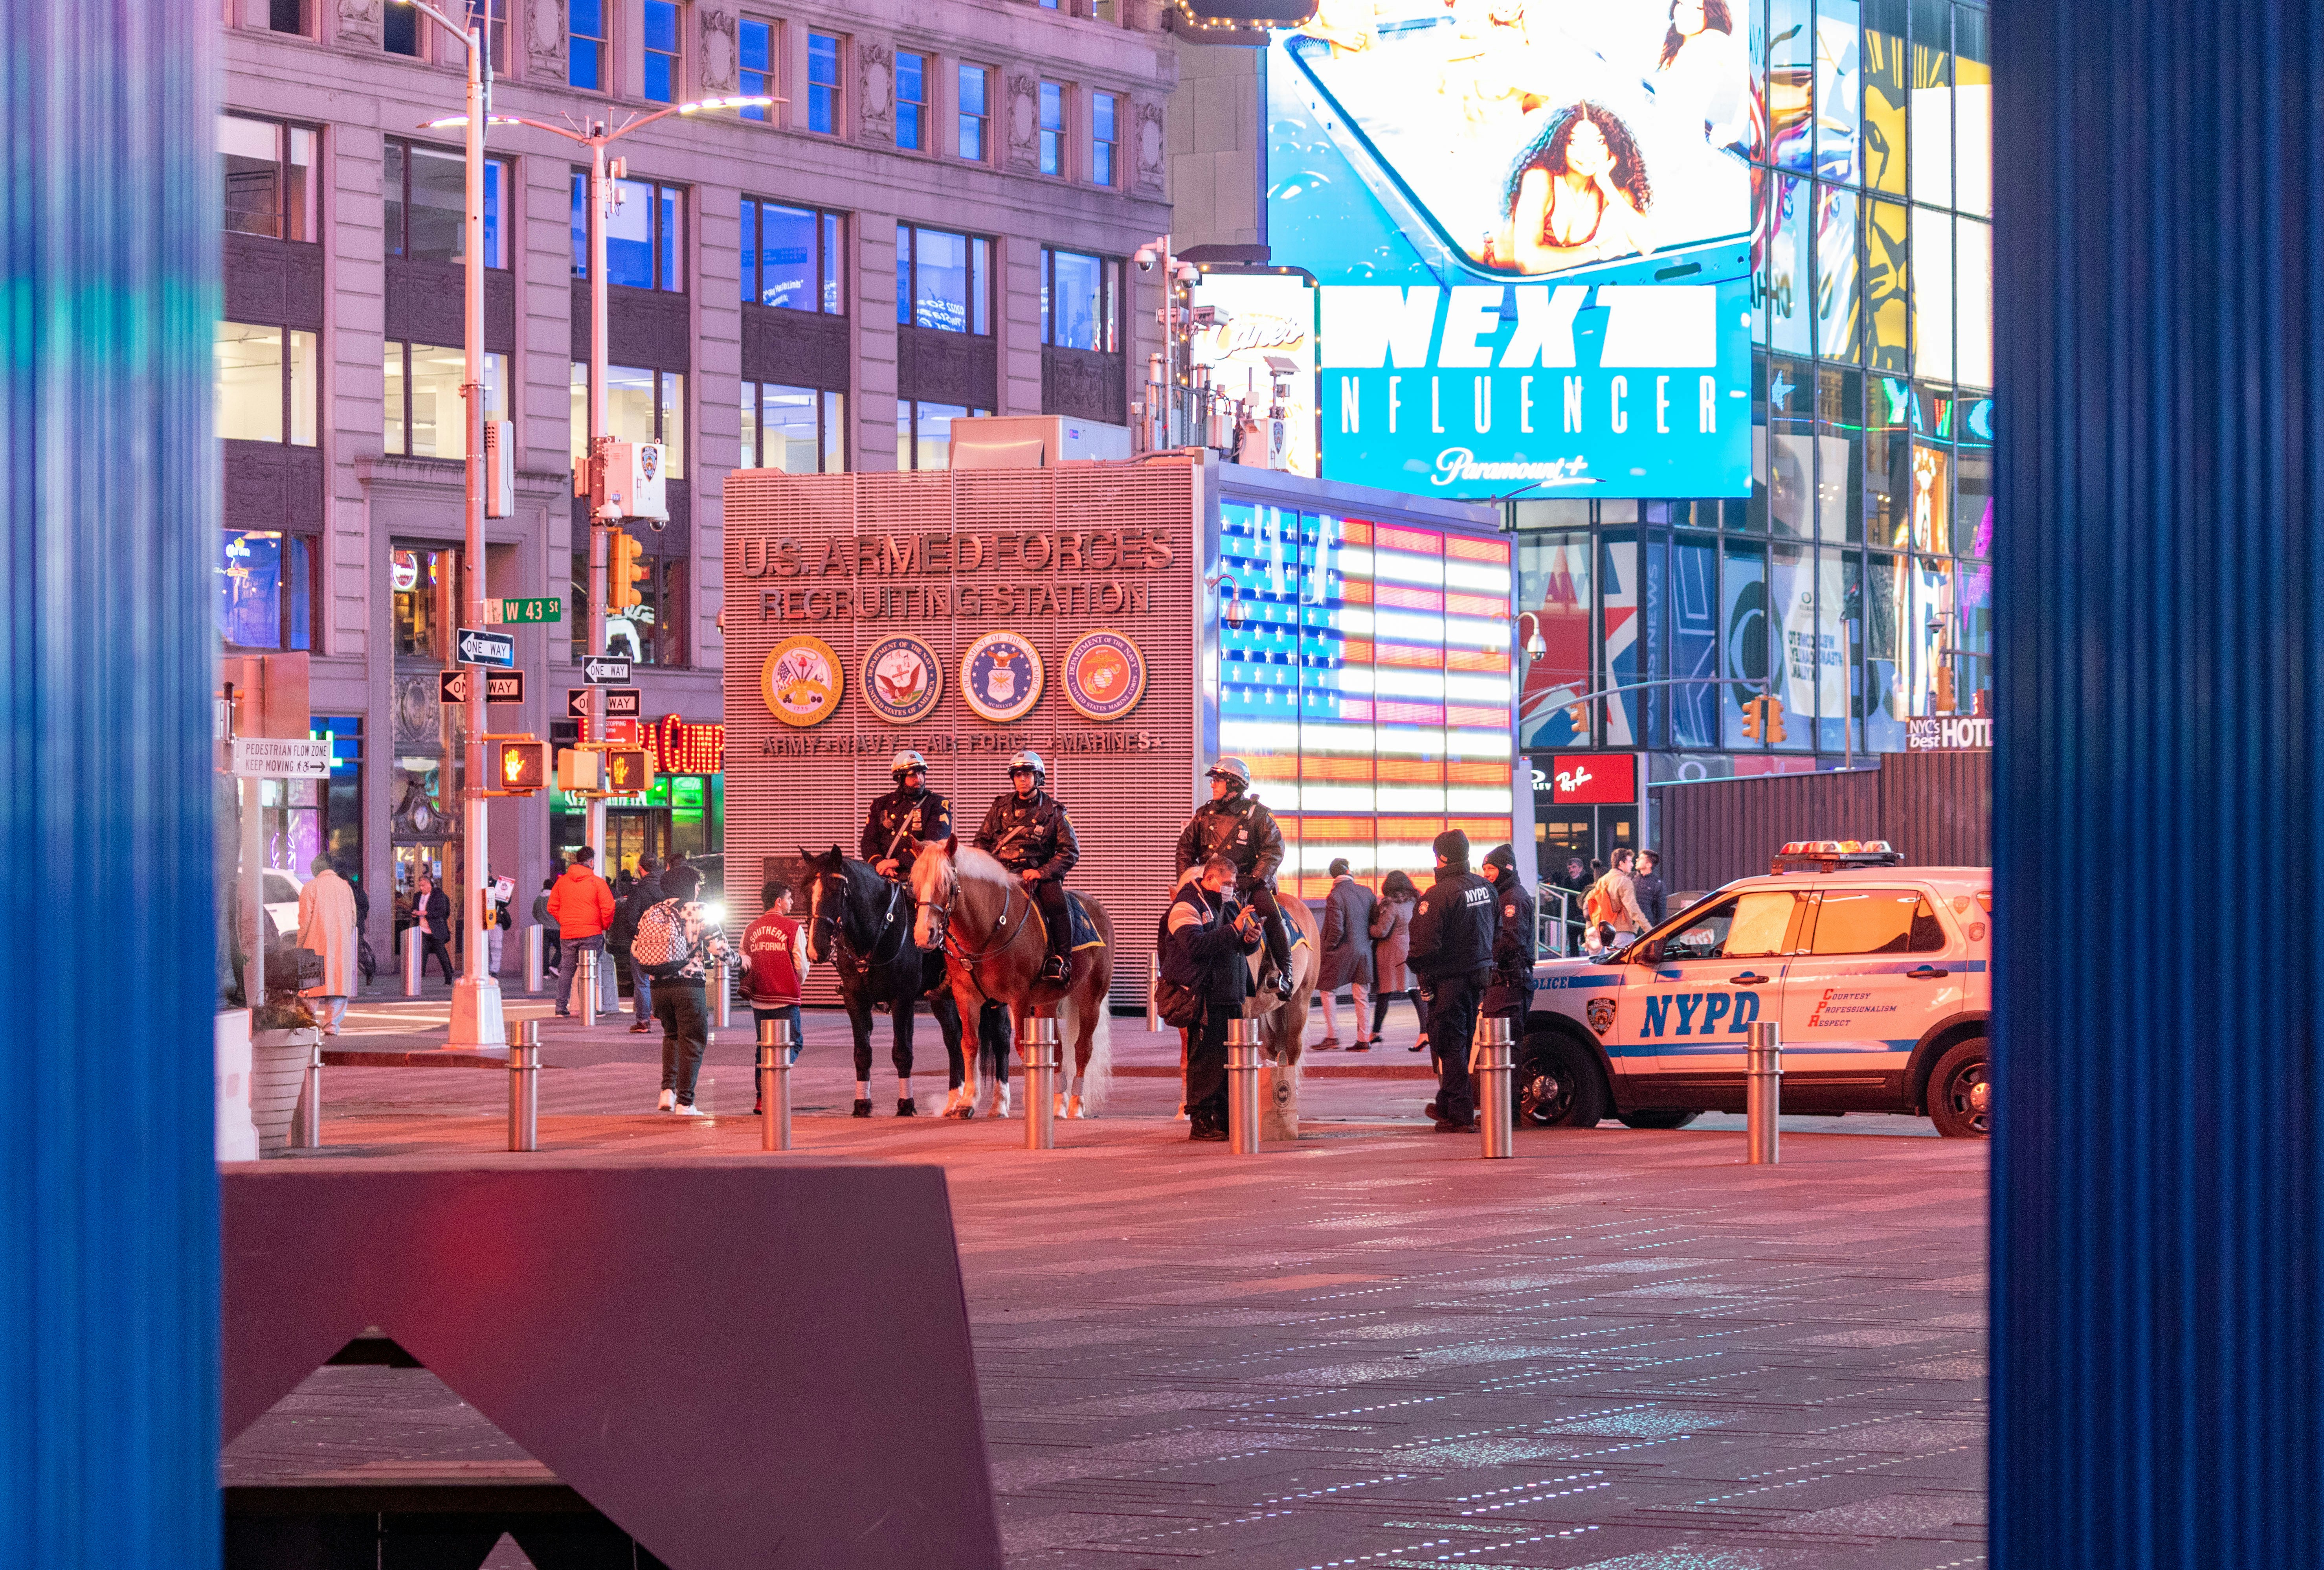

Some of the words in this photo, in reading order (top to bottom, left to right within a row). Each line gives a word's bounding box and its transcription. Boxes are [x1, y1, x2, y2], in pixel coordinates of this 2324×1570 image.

[1321, 285, 1716, 368] NEXT
[1342, 375, 1716, 434] NFLUENCER
[1432, 447, 1588, 485] Paramount+
[738, 537, 809, 577] U.S.
[817, 533, 983, 575] ARMED
[991, 529, 1174, 570] FORCES
[759, 584, 980, 620] RECRUITING
[992, 581, 1149, 614] STATION
[1647, 564, 1658, 647] NEWS
[506, 602, 519, 620] W
[526, 601, 543, 620] 43
[549, 601, 558, 612] St
[466, 640, 483, 653] ONE
[490, 643, 506, 656] WAY
[1069, 636, 1103, 675] DEPARTMENT
[1113, 639, 1124, 649] THE
[1123, 647, 1138, 668] NAVY
[767, 640, 802, 675] DEPARTMENT
[818, 645, 829, 656] THE
[830, 659, 840, 679] ARMY
[867, 642, 897, 677] DEPARTMENT
[911, 643, 923, 654] THE
[922, 653, 934, 670] NAVY
[963, 640, 987, 689] DEPARTMENT
[1007, 635, 1023, 646] THE
[1024, 647, 1036, 660] AIR
[1031, 665, 1040, 693] FORCE
[591, 665, 604, 675] ONE
[611, 666, 625, 676] WAY
[454, 682, 466, 693] ON
[488, 682, 512, 693] WAY
[1071, 682, 1086, 704] UNITED
[1086, 702, 1106, 711] STATES
[1109, 695, 1129, 710] MARINE
[1129, 675, 1138, 695] CORPS
[609, 698, 630, 708] WAY
[765, 682, 778, 709] UNITED
[780, 710, 806, 722] STATES
[818, 686, 839, 716] AMERICA
[867, 685, 884, 708] UNITED
[883, 705, 907, 715] STATES
[917, 680, 935, 709] AMERICA
[1910, 720, 1940, 734] NYC's
[246, 743, 292, 756] PEDESTRIAN
[294, 745, 310, 757] FLOW
[311, 745, 327, 757] ZONE
[761, 736, 820, 754] ARMY
[837, 735, 899, 753] NAVY
[925, 734, 955, 752] AIR
[1060, 731, 1150, 751] MARINES
[1910, 733, 1940, 748] best
[246, 759, 263, 771] KEEP
[266, 760, 294, 772] MOVING
[1465, 887, 1489, 903] NYPD
[750, 926, 788, 943] SOUTHERN
[750, 941, 786, 952] CALIFORNIA
[1533, 977, 1568, 990] OLICE
[1823, 989, 1871, 1000] COURTESY
[1640, 991, 1760, 1038] NYPD
[1815, 1002, 1897, 1013] PROFESSIONALISM
[1808, 1015, 1851, 1027] RESPECT
